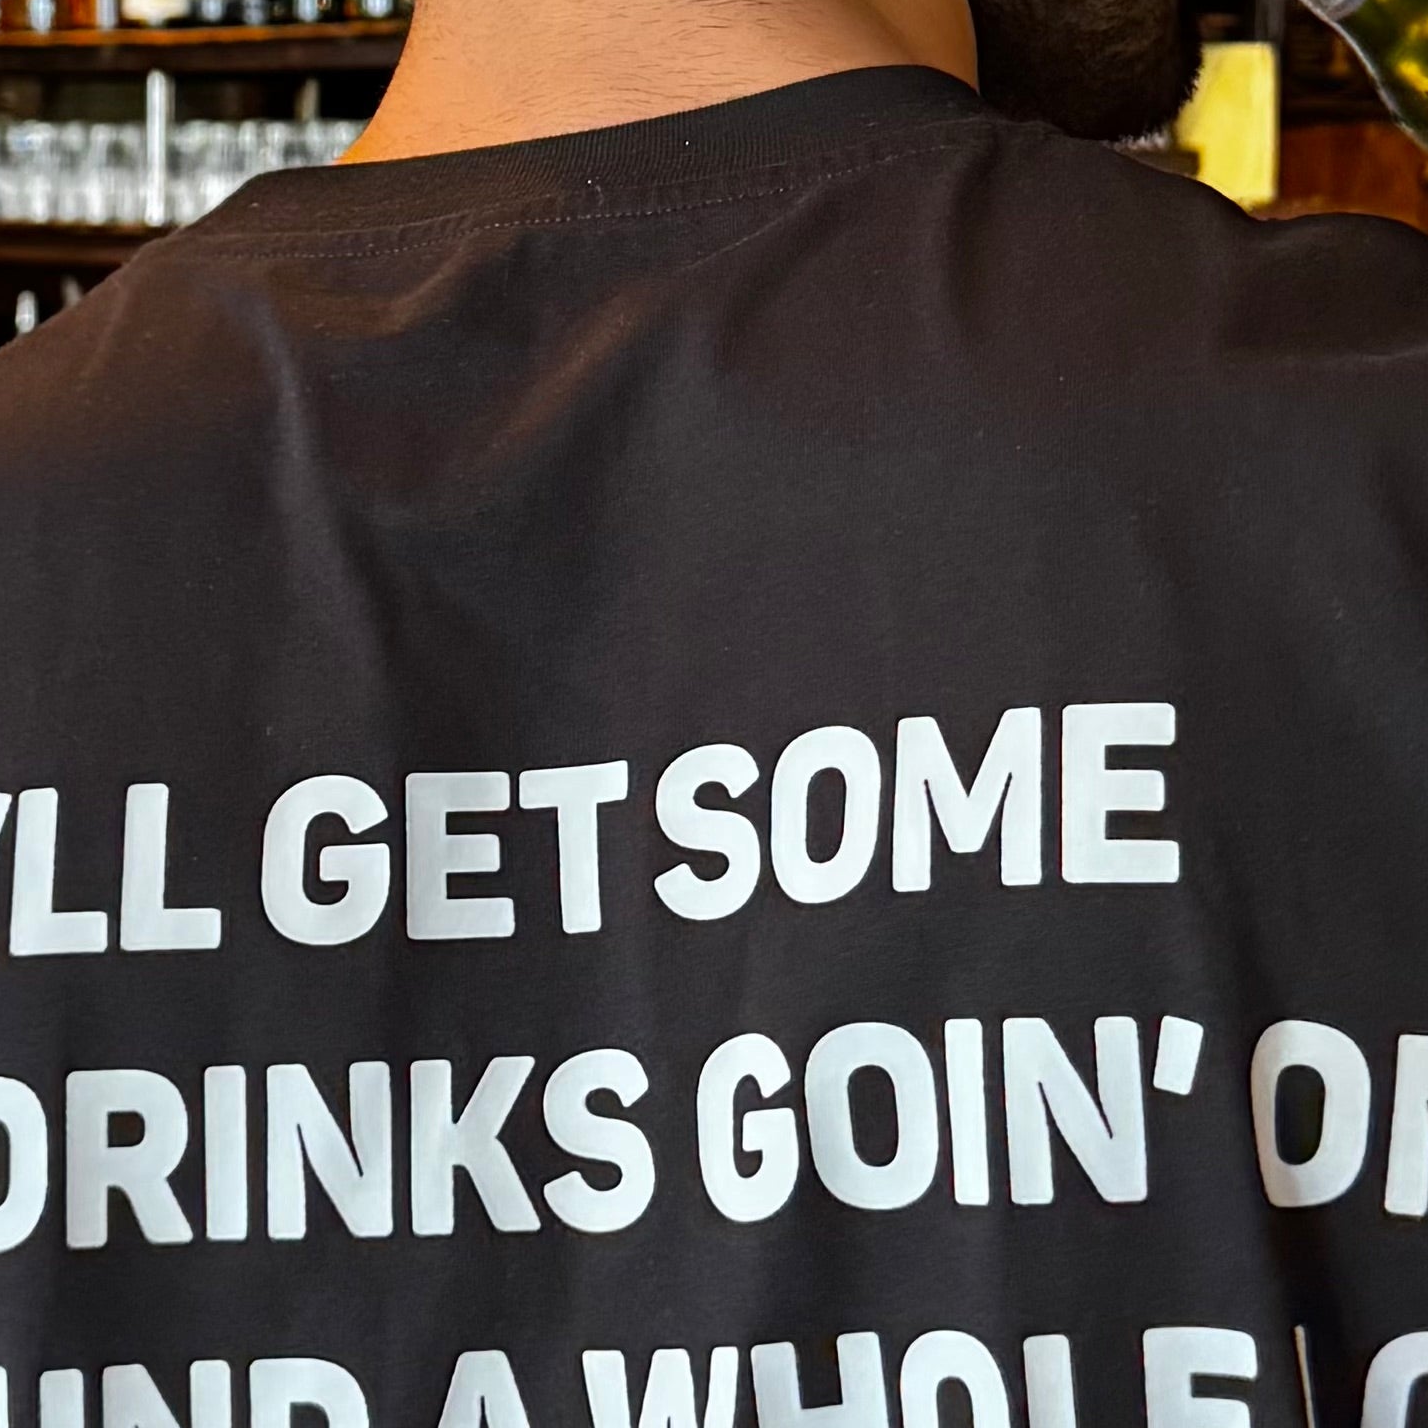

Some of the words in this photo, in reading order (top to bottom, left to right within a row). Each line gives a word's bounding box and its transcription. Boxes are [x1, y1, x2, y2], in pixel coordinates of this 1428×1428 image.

[261, 760, 628, 945] GET
[654, 703, 1180, 920] SOME
[697, 1015, 1204, 1224] GOIN'
